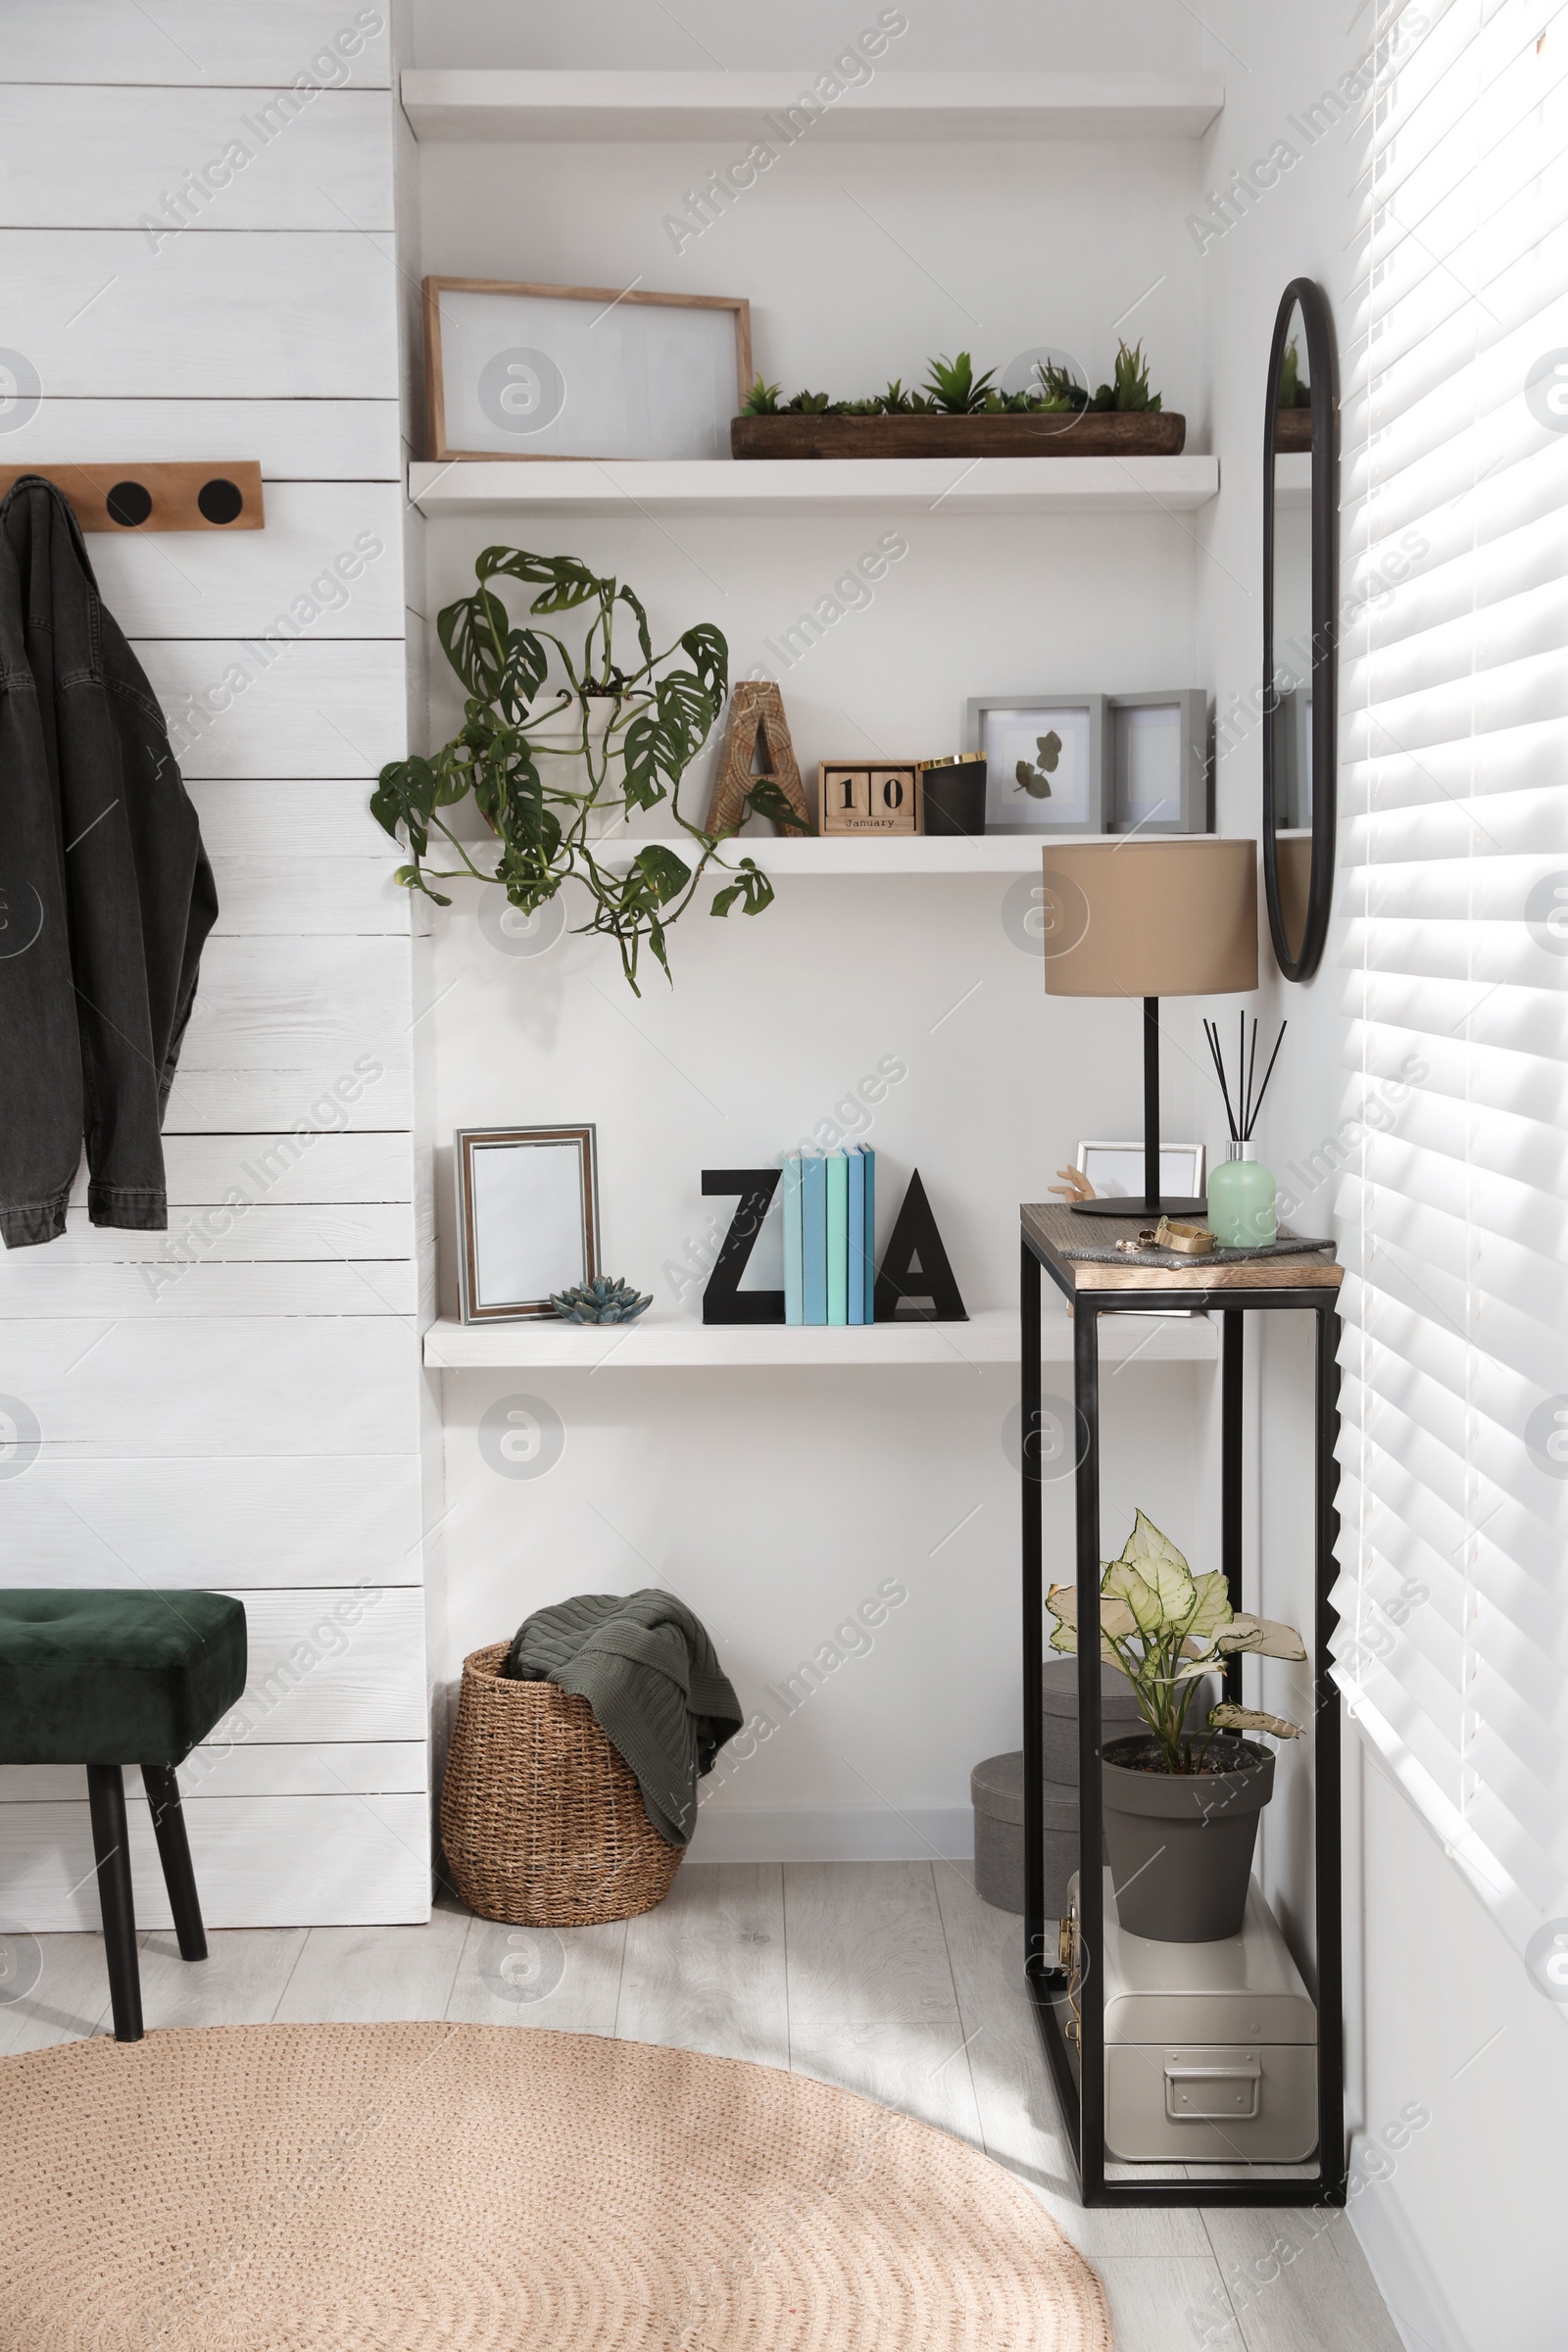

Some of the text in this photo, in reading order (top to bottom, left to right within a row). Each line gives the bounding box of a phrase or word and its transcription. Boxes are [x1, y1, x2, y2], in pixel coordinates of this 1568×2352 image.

[705, 681, 813, 837] A
[845, 818, 894, 829] January
[702, 1169, 786, 1324] Z
[874, 1167, 969, 1322] A
